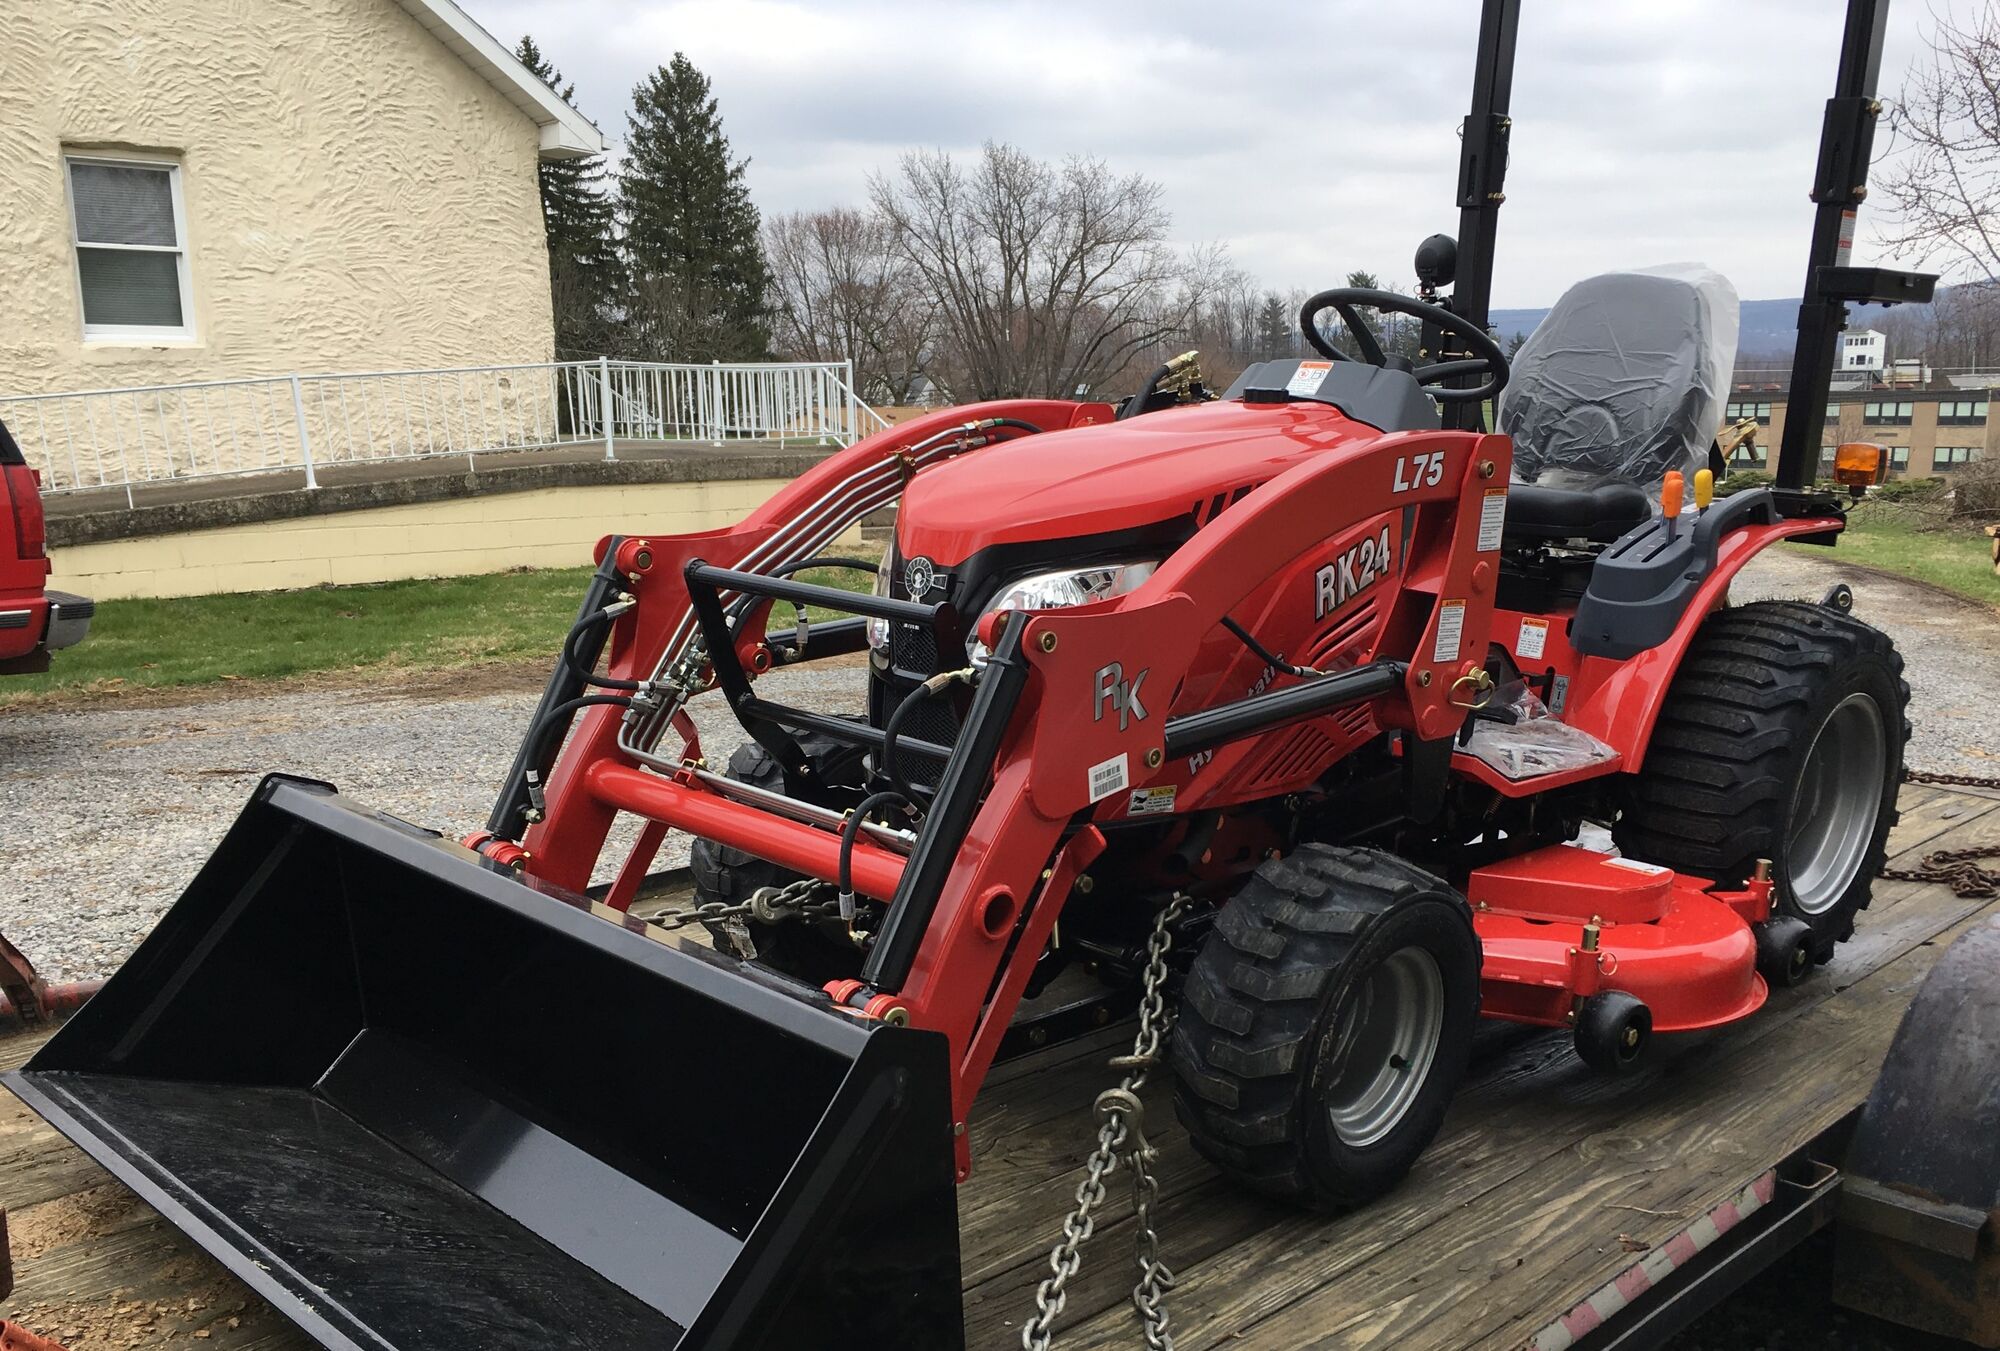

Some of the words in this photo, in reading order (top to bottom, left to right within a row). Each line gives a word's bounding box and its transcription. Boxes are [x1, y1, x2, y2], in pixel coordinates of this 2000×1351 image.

[1391, 450, 1446, 493] L75
[1314, 523, 1390, 623] RK24
[1094, 660, 1150, 732] RK
